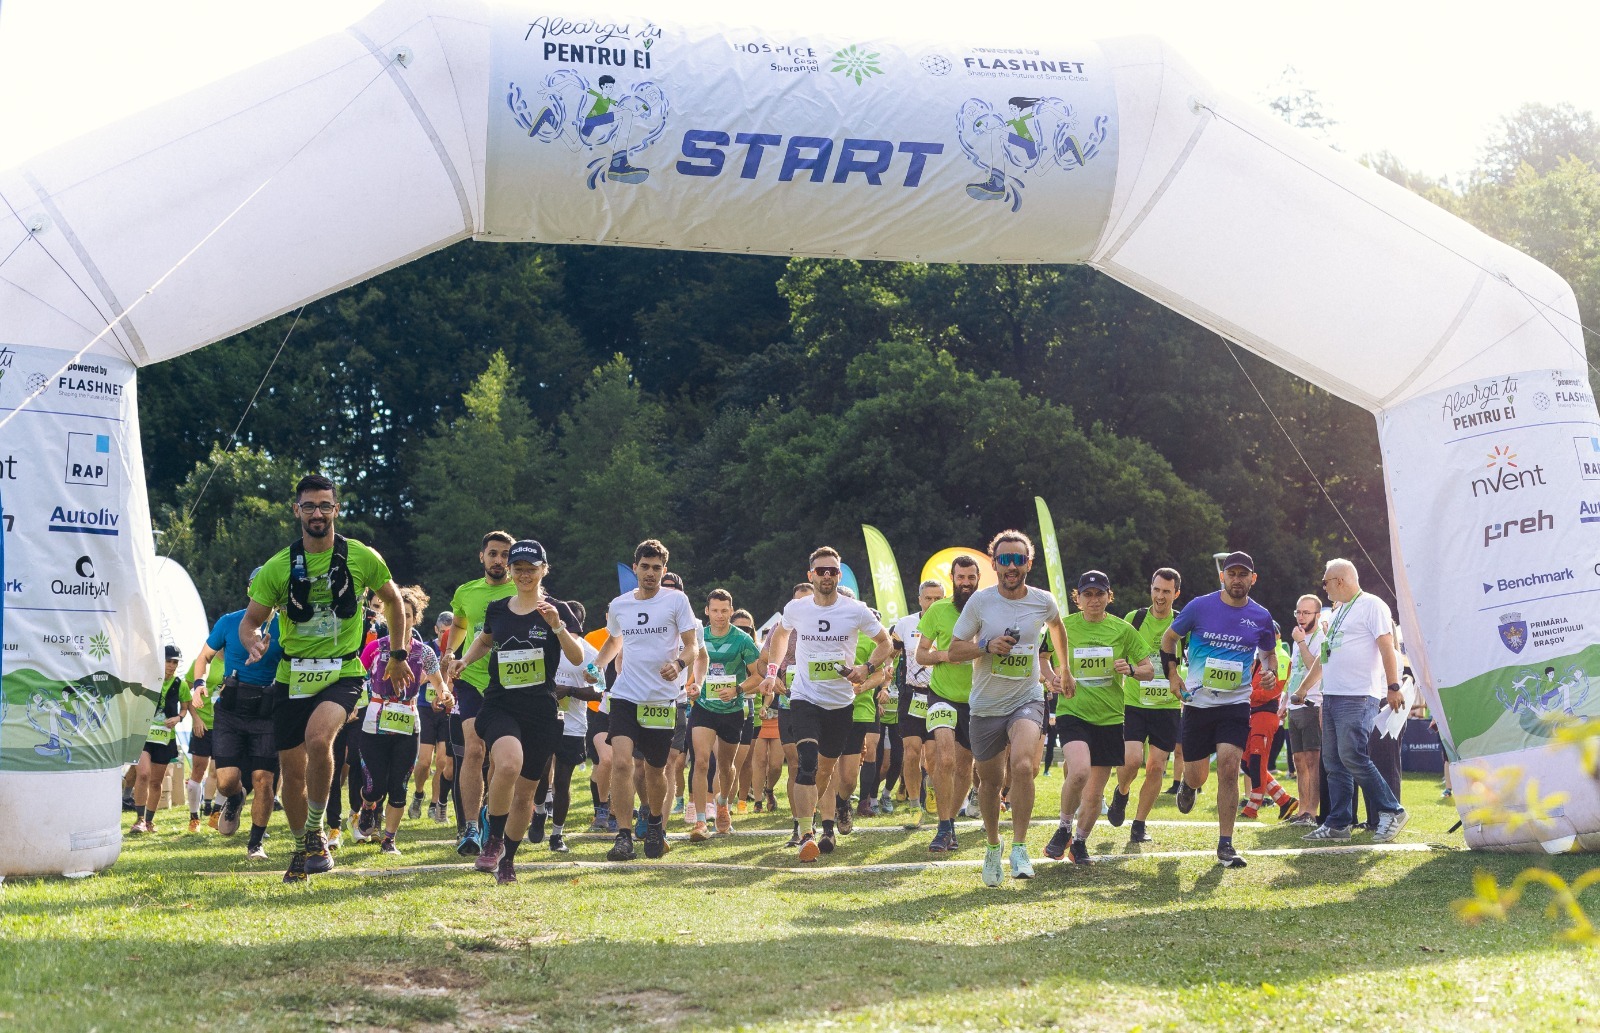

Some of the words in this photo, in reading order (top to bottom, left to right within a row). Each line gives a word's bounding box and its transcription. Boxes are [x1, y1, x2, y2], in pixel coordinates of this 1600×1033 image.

[544, 42, 625, 67] PENTRU
[634, 49, 651, 69] EI
[963, 57, 1084, 73] FLASHNET
[676, 129, 944, 187] START
[67, 363, 99, 374] powered
[100, 365, 107, 376] by
[59, 377, 123, 396] FLASHNET
[1453, 409, 1500, 430] PENTRU
[1503, 406, 1516, 420] EI
[72, 463, 103, 479] RAP
[50, 506, 119, 526] Autoliv
[1484, 509, 1554, 547] preh
[511, 546, 537, 555] adidas
[1496, 568, 1575, 592] Benchmark
[1530, 617, 1569, 629] PRIMĂRIA
[1203, 631, 1243, 643] BRASOV
[1532, 623, 1584, 638] MUNICIPIULUI
[43, 634, 85, 644] HOSPICE
[1000, 655, 1028, 667] 2050
[1080, 658, 1106, 669] 2011
[506, 661, 536, 675] 2001
[298, 671, 332, 683] 2057
[1210, 669, 1236, 682] 2010
[1145, 687, 1168, 697] 2032
[386, 711, 410, 724] 2043
[643, 706, 670, 718] 2039
[930, 710, 952, 720] 2054
